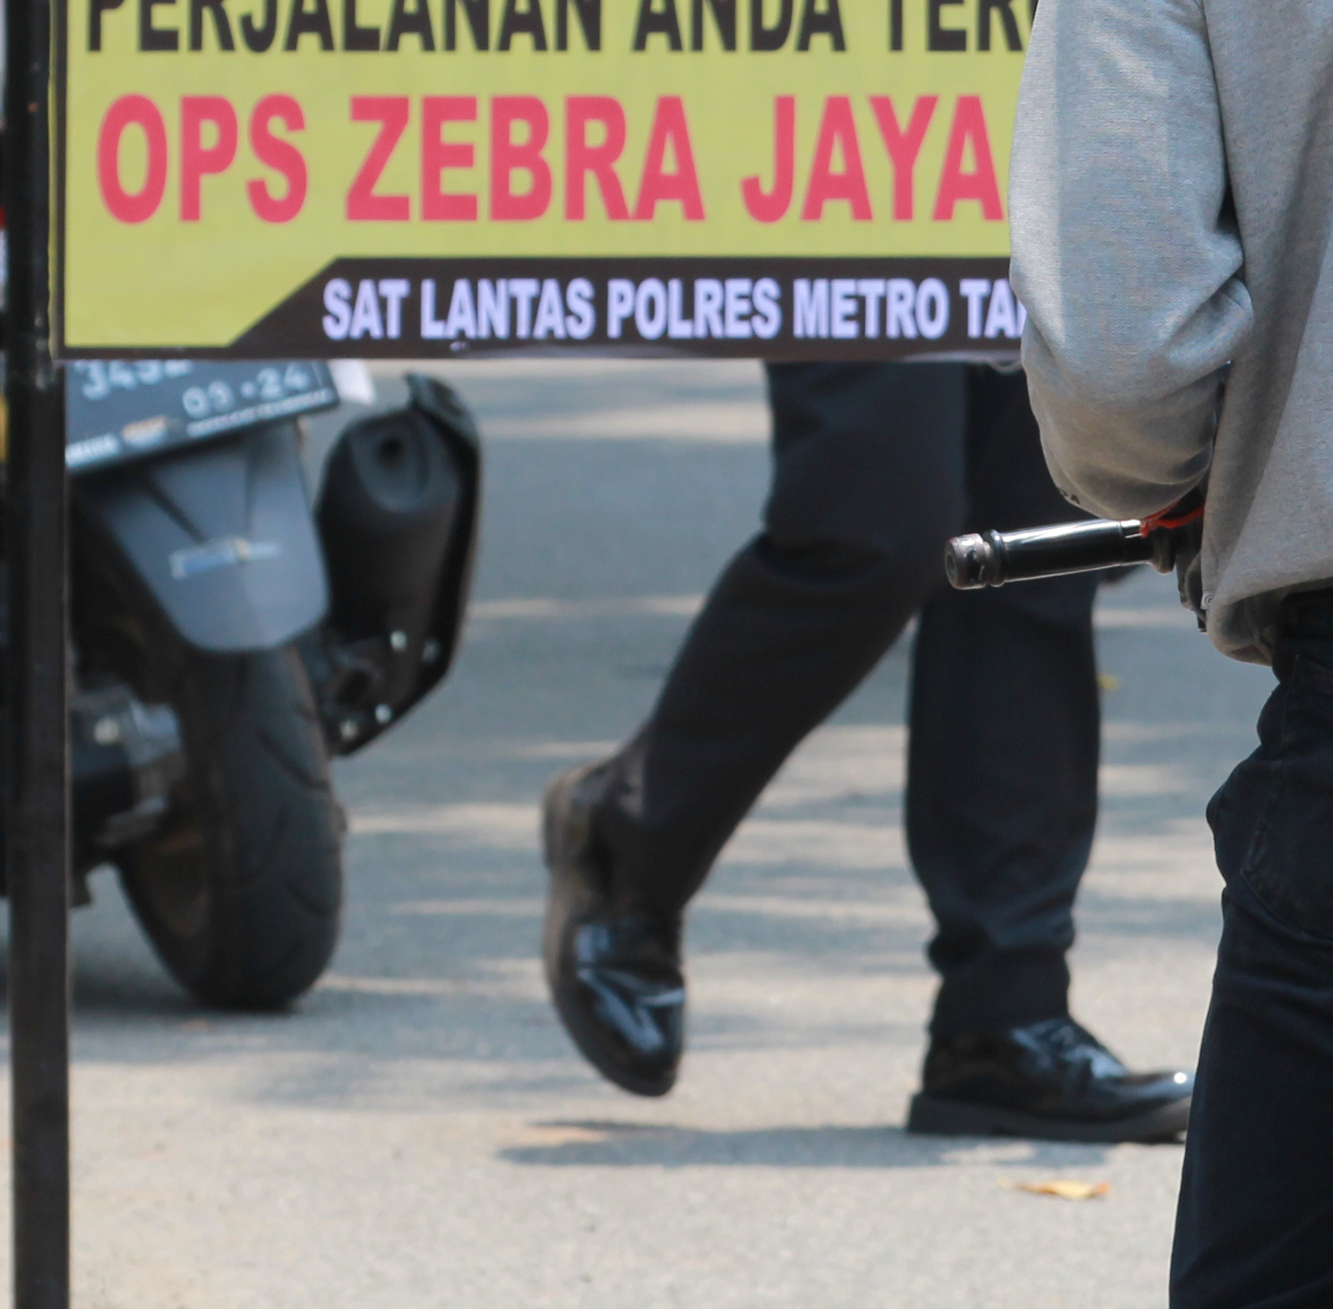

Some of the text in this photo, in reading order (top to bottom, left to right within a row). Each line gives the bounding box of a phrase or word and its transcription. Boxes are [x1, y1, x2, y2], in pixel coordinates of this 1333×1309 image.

[96, 93, 1006, 224] OPS ZEBRA JAYA
[322, 277, 410, 340] SAT
[420, 277, 597, 340] LANTAS
[606, 277, 783, 340] POLRES
[792, 277, 950, 340] METRO
